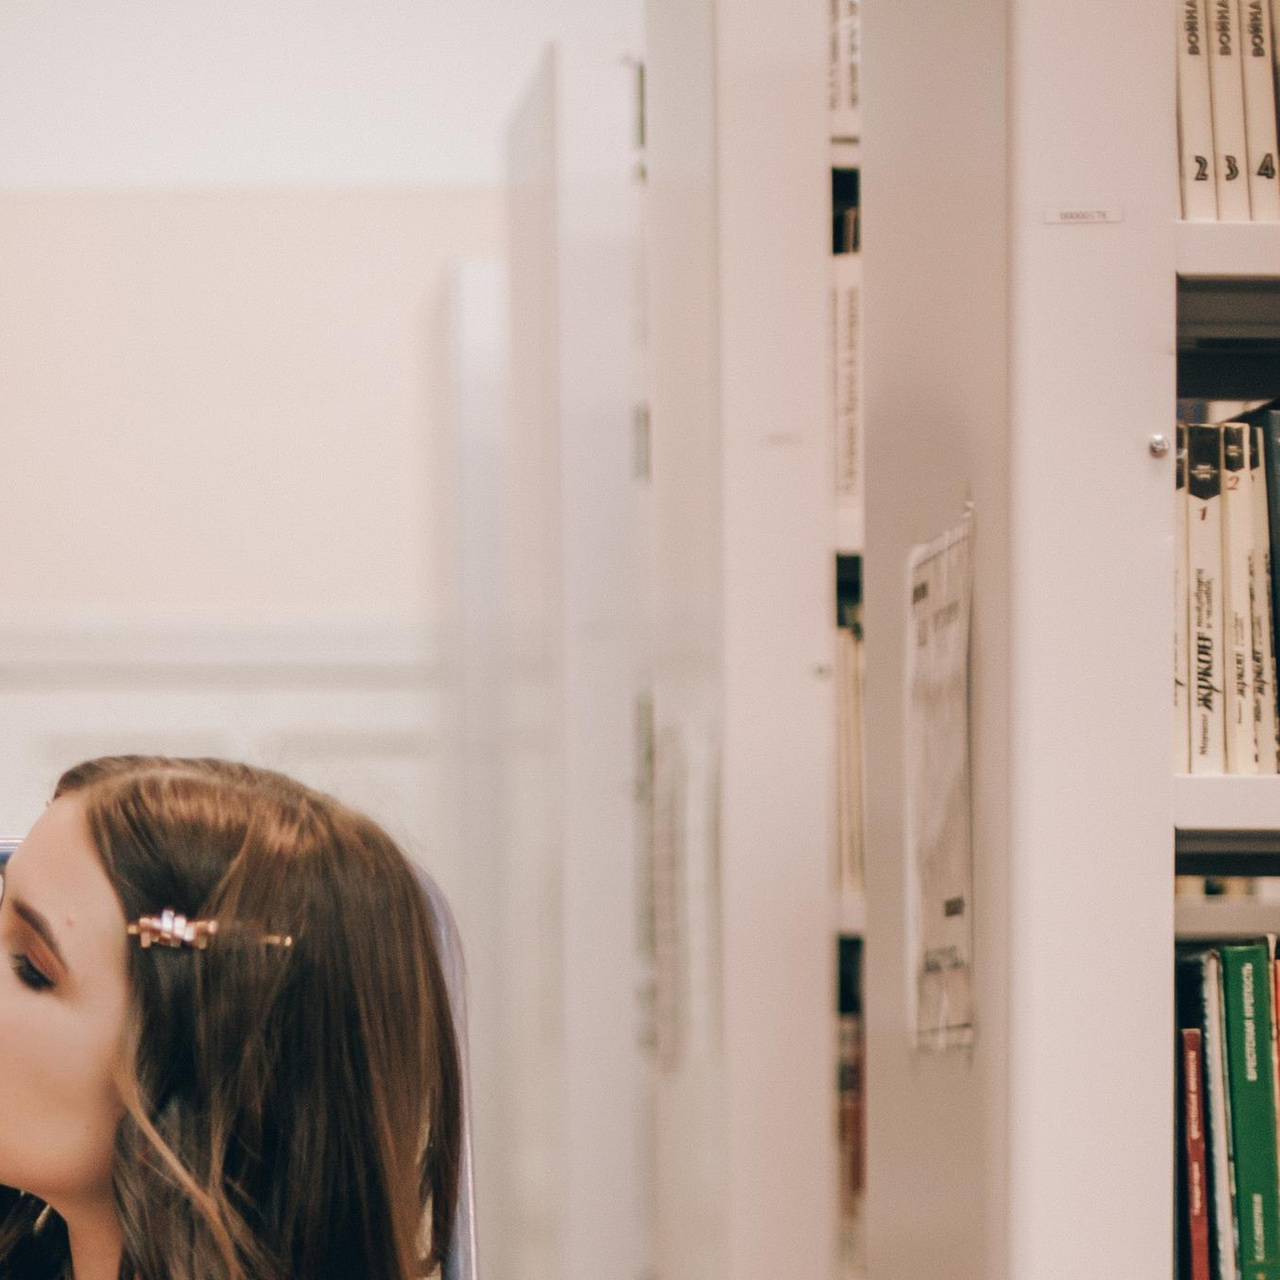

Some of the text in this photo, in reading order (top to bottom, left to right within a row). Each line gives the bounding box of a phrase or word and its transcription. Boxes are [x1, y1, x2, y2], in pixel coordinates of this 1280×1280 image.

[1194, 155, 1209, 181] 2
[1225, 155, 1239, 181] 3
[1256, 153, 1276, 180] 4
[1225, 475, 1240, 491] 2
[1198, 506, 1207, 522] 1
